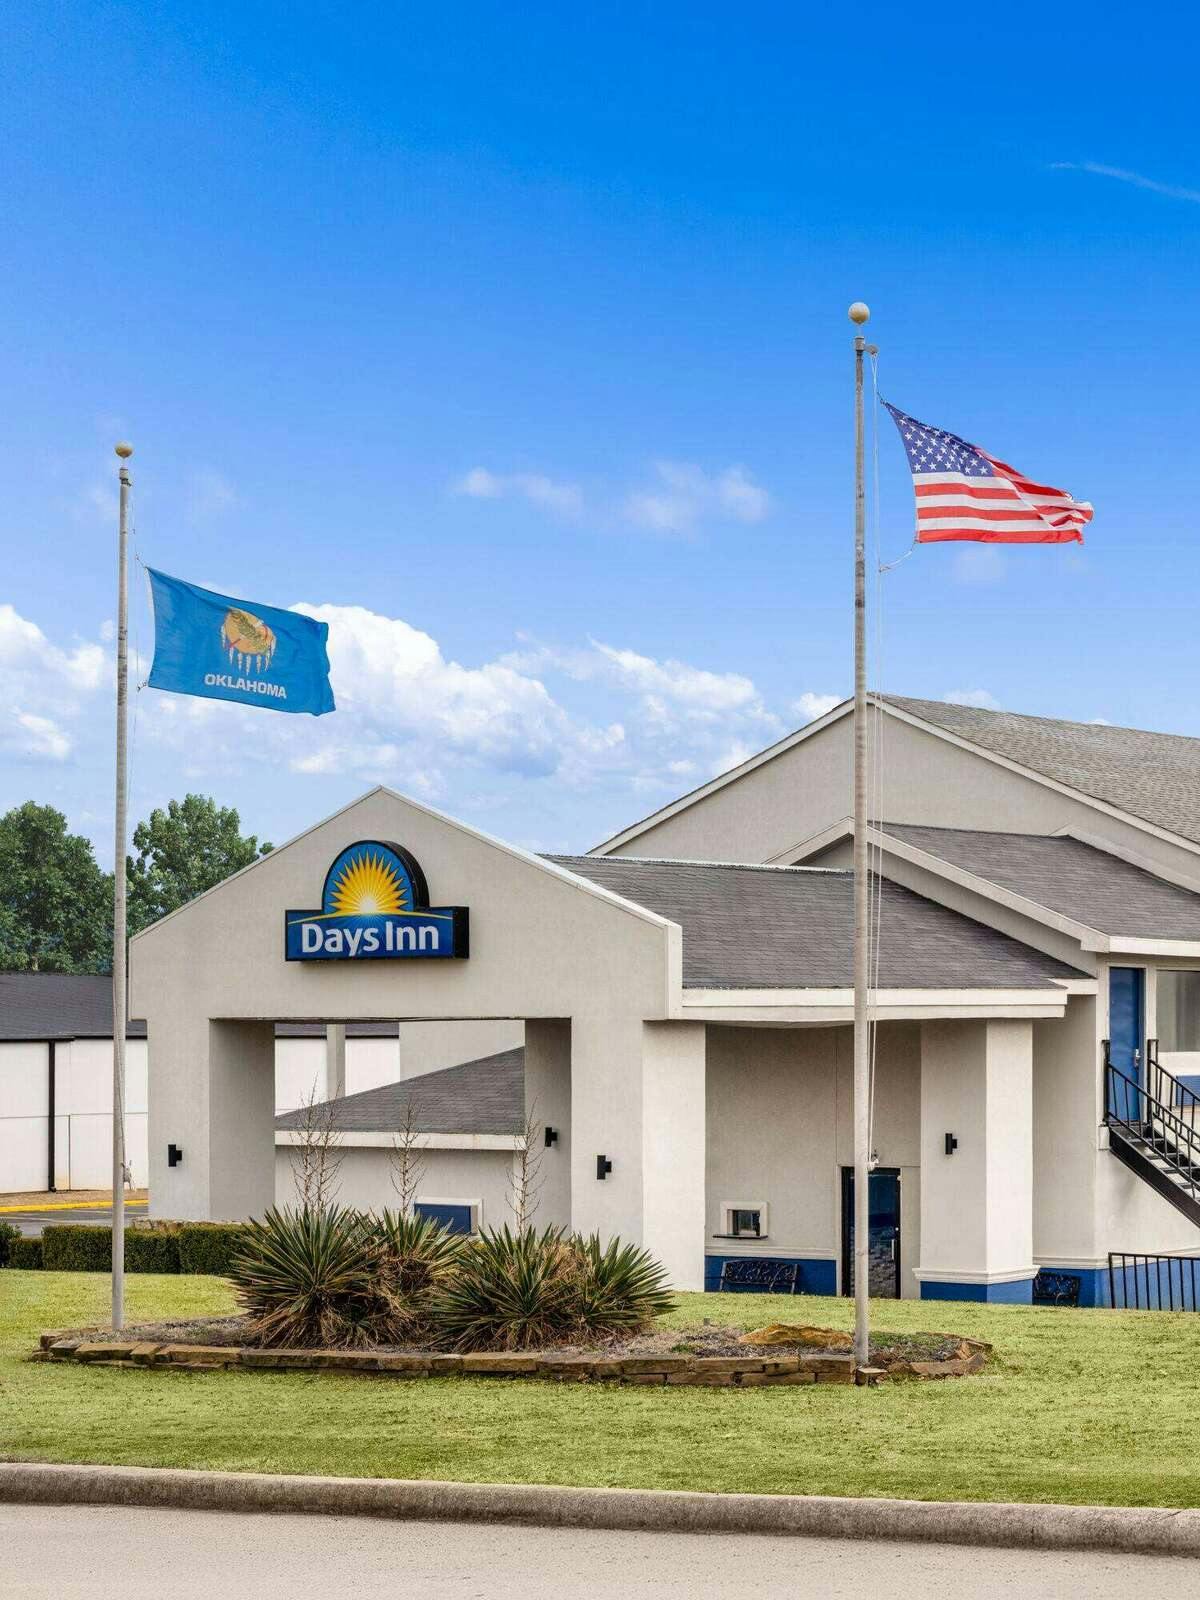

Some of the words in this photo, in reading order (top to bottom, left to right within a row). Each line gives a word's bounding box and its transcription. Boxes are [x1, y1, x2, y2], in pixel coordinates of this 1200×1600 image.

[204, 673, 287, 699] OKLAHOMA
[301, 923, 380, 957] Days
[385, 921, 439, 951] Inn
